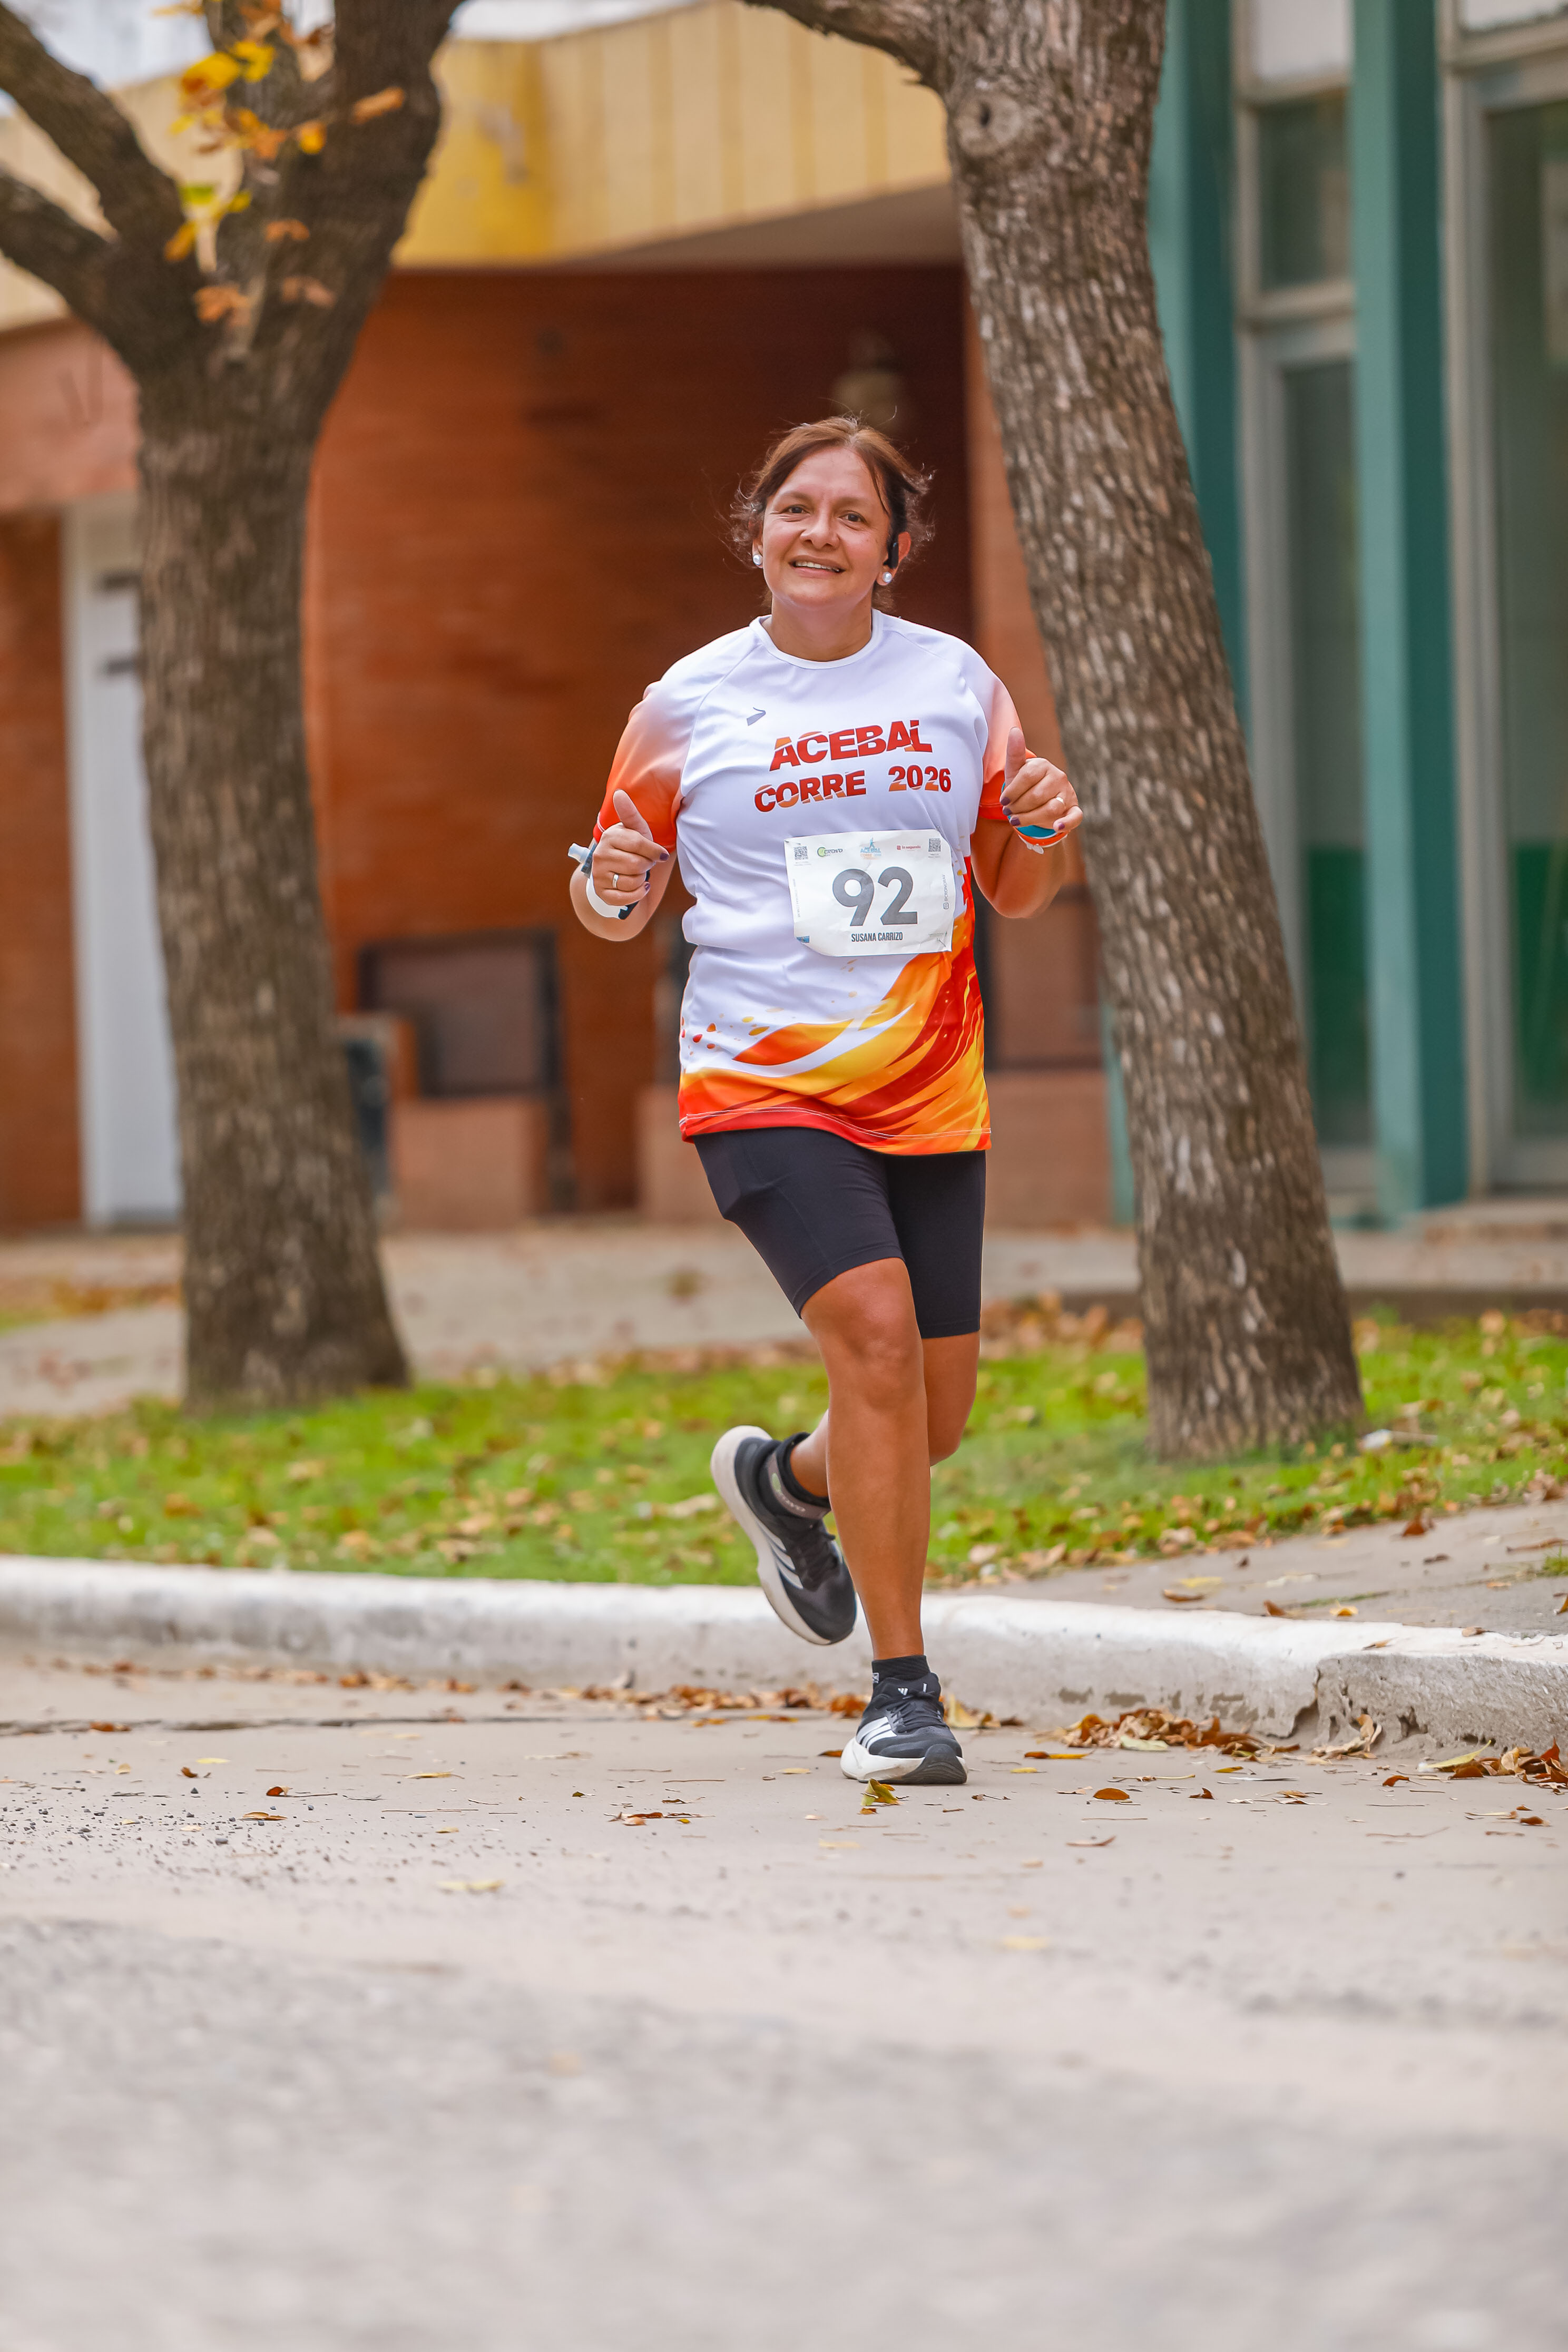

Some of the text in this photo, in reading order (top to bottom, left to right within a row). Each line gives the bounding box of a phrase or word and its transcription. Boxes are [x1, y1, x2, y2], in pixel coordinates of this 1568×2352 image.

[769, 720, 933, 771] ACEBAL
[754, 765, 952, 812] CORRE 2026
[832, 867, 917, 926] 92
[851, 932, 903, 942] SUSANA CARRIZO
